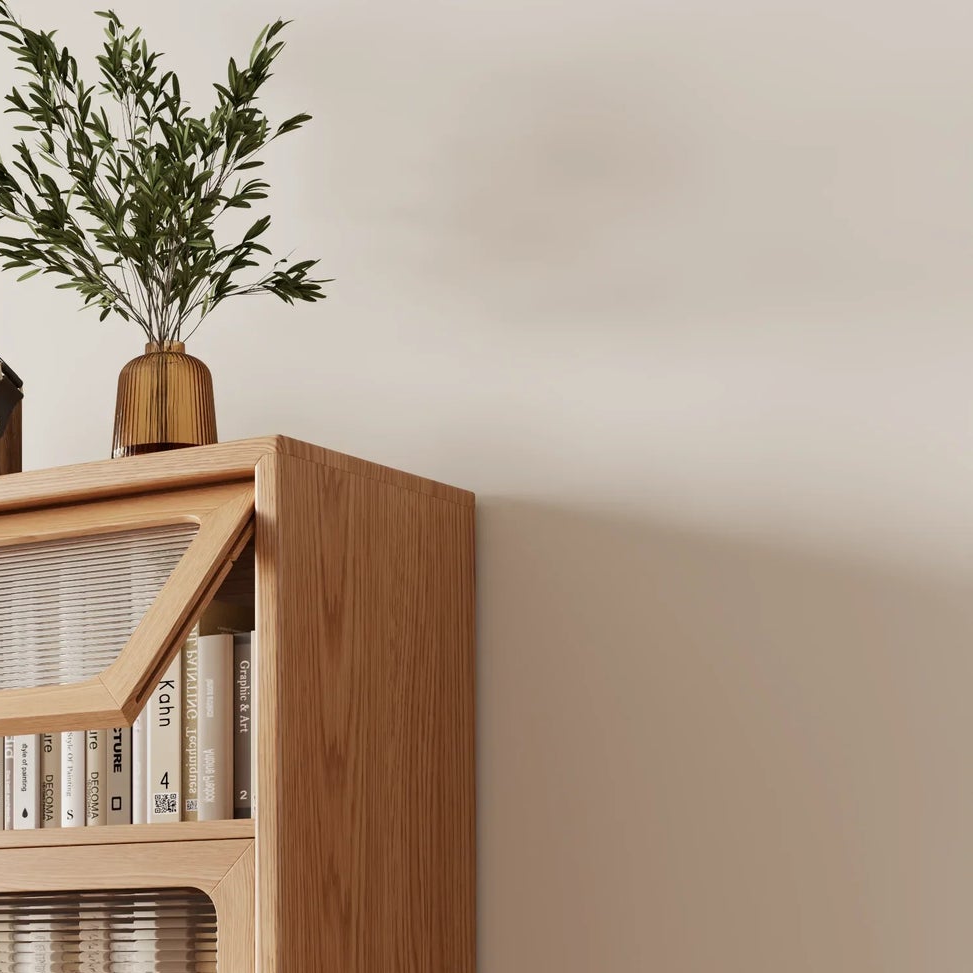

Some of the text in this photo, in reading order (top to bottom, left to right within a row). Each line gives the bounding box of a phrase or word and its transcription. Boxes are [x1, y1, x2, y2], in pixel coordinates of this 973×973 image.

[159, 680, 175, 727] Kahn
[237, 660, 250, 733] Graphic & Art
[65, 732, 74, 751] Style
[20, 767, 28, 792] painting
[65, 766, 74, 797] Painting
[160, 771, 170, 790] 4
[239, 790, 248, 800] 2
[45, 775, 54, 821] DECOMA
[90, 772, 100, 819] DECOMA
